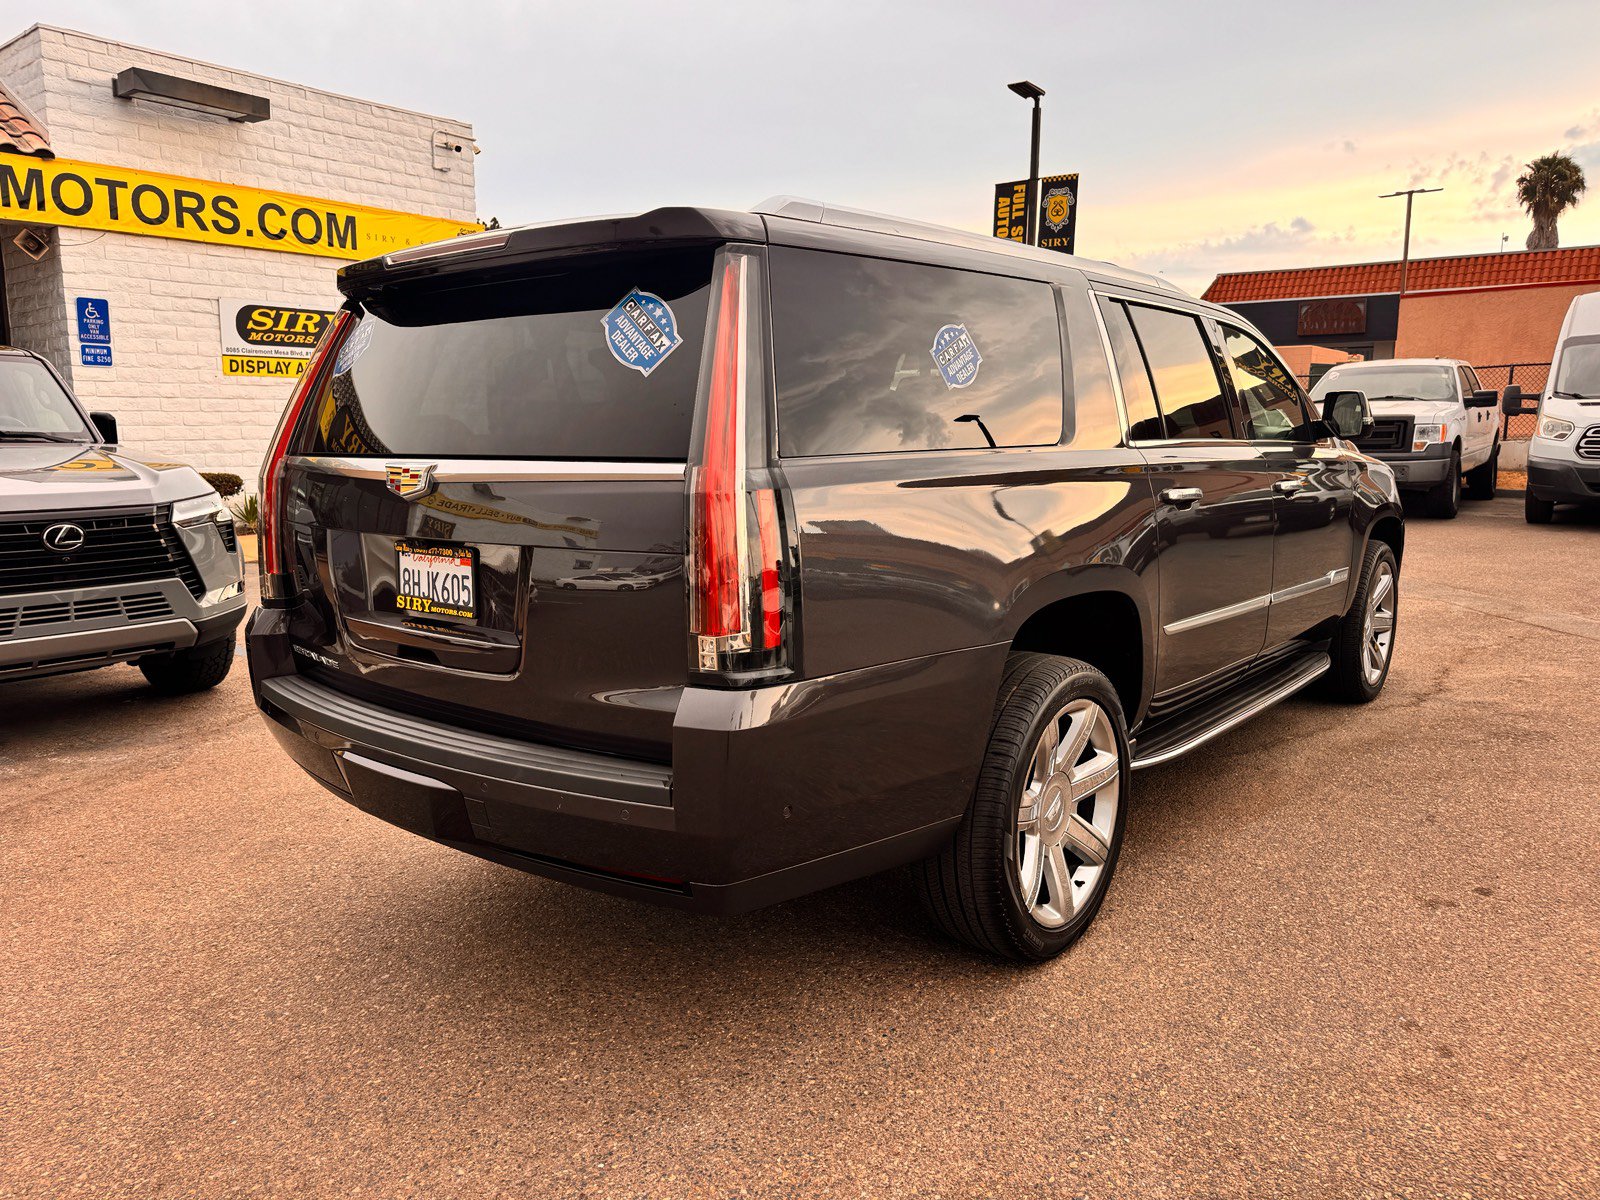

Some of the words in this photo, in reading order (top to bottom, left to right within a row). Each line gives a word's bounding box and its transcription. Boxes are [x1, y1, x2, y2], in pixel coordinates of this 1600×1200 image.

[0, 164, 357, 250] MOTORS.COM
[1012, 184, 1026, 219] FULL
[997, 197, 1010, 238] AUTO
[366, 233, 395, 243] SIRY
[1041, 237, 1070, 247] SIRY
[614, 313, 655, 360] ADVANTAGE
[625, 300, 667, 352] CARFAX
[85, 347, 108, 355] MINIMUM
[241, 347, 273, 355] Clairemont
[611, 329, 639, 363] DEALER
[939, 333, 971, 365] CARFAX
[229, 359, 291, 375] DISPLAY
[296, 361, 308, 375] A
[947, 347, 975, 377] ADVANTAGE
[956, 362, 976, 383] DEALER
[402, 567, 471, 606] 8HJK605
[396, 595, 432, 613] SIRY
[431, 606, 473, 618] MOTORS.COM
